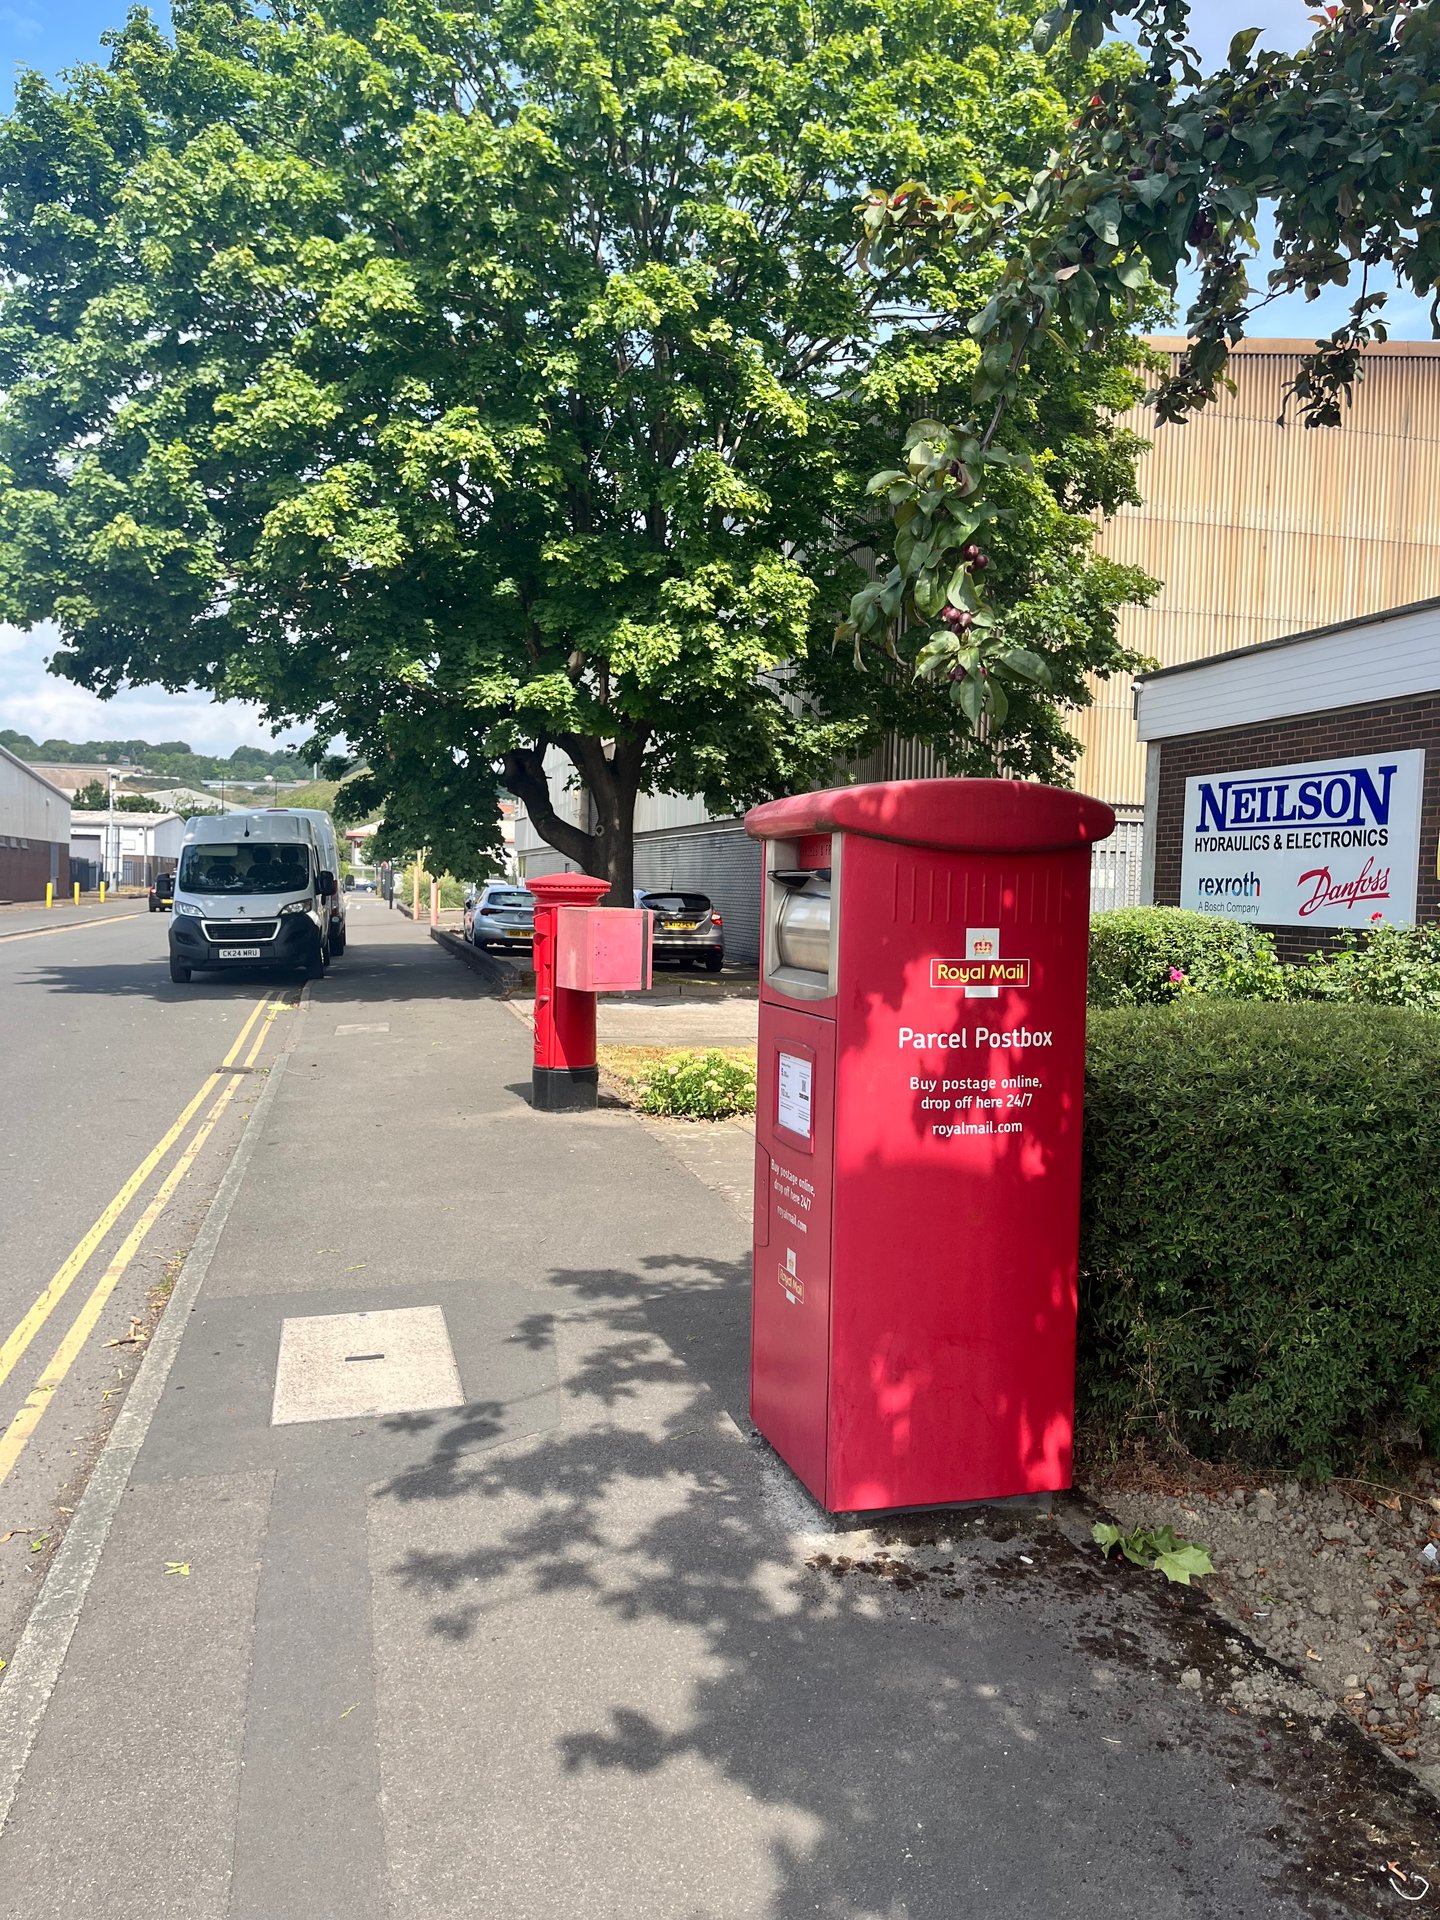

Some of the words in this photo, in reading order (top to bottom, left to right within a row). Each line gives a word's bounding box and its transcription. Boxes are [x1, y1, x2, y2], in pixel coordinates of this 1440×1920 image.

[1196, 765, 1397, 832] NEILSON
[1195, 834, 1270, 852] HYDRAULICS
[1273, 834, 1282, 850] &
[1286, 828, 1388, 850] ELECTRONICS
[1198, 871, 1261, 897] rexroth
[1297, 856, 1390, 916] Danfoss
[1198, 902, 1204, 911] A
[1204, 902, 1225, 912] Bosch
[1226, 903, 1260, 916] Company
[937, 964, 985, 983] Royal
[989, 964, 1024, 980] Mail
[899, 1027, 967, 1049] Parcel
[975, 1026, 1052, 1048] Postbox
[910, 1077, 937, 1092] Buy
[942, 1077, 996, 1092] postage
[1001, 1075, 1042, 1089] online,
[921, 1097, 950, 1112] drop
[955, 1096, 973, 1109] off
[976, 1096, 1003, 1108] here
[1006, 1093, 1032, 1108] 24/7
[932, 1121, 1023, 1137] royalmail.com
[771, 1158, 780, 1176] Buy
[780, 1167, 798, 1186] postage
[774, 1178, 783, 1194] drop
[790, 1188, 800, 1204] here
[800, 1194, 811, 1211] 24/7
